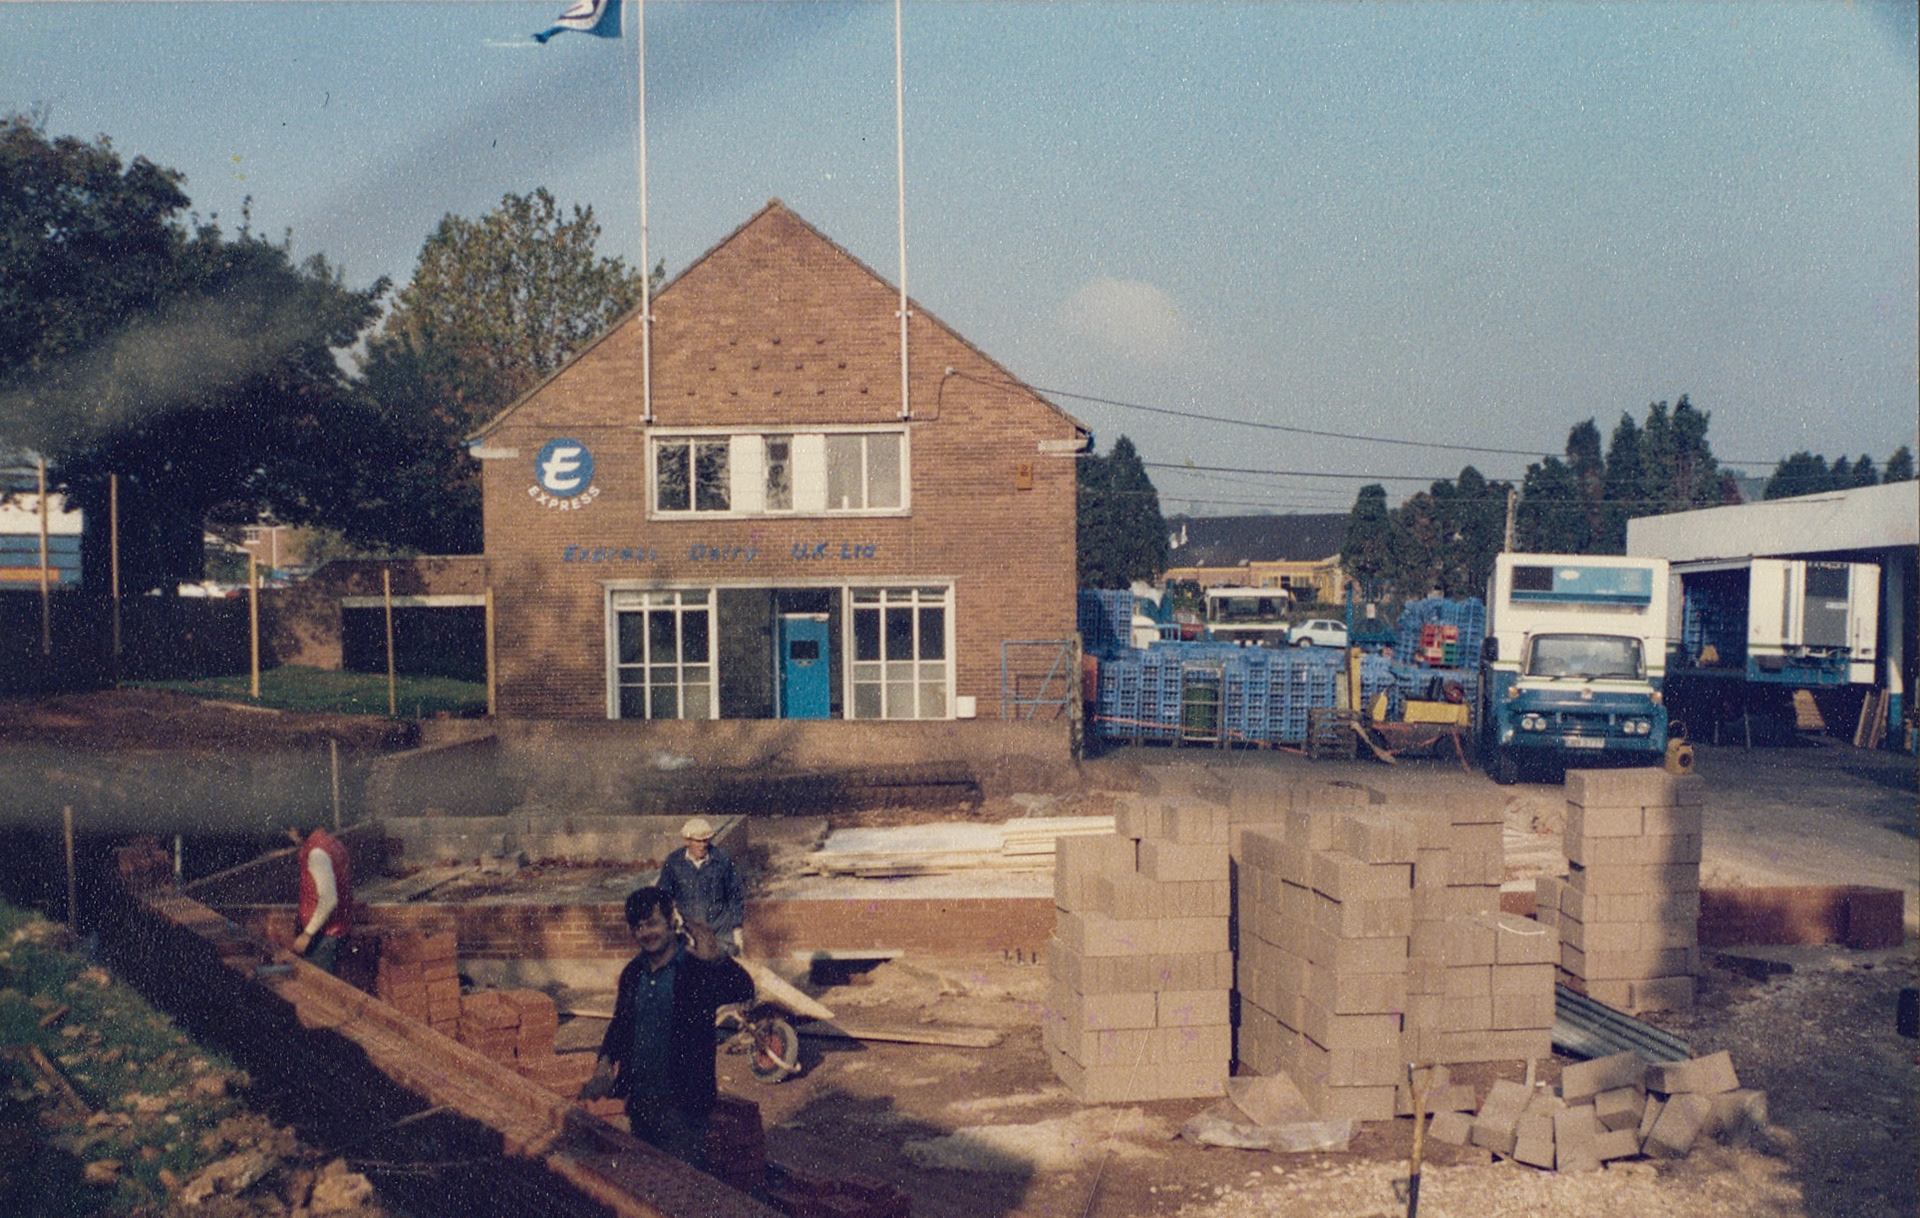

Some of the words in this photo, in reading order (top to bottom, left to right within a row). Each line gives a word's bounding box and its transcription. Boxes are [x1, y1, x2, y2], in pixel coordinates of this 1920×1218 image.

[528, 485, 600, 511] EXPRESS
[563, 545, 658, 564] Express
[689, 542, 758, 563] Dairy
[841, 541, 877, 559] Ltd
